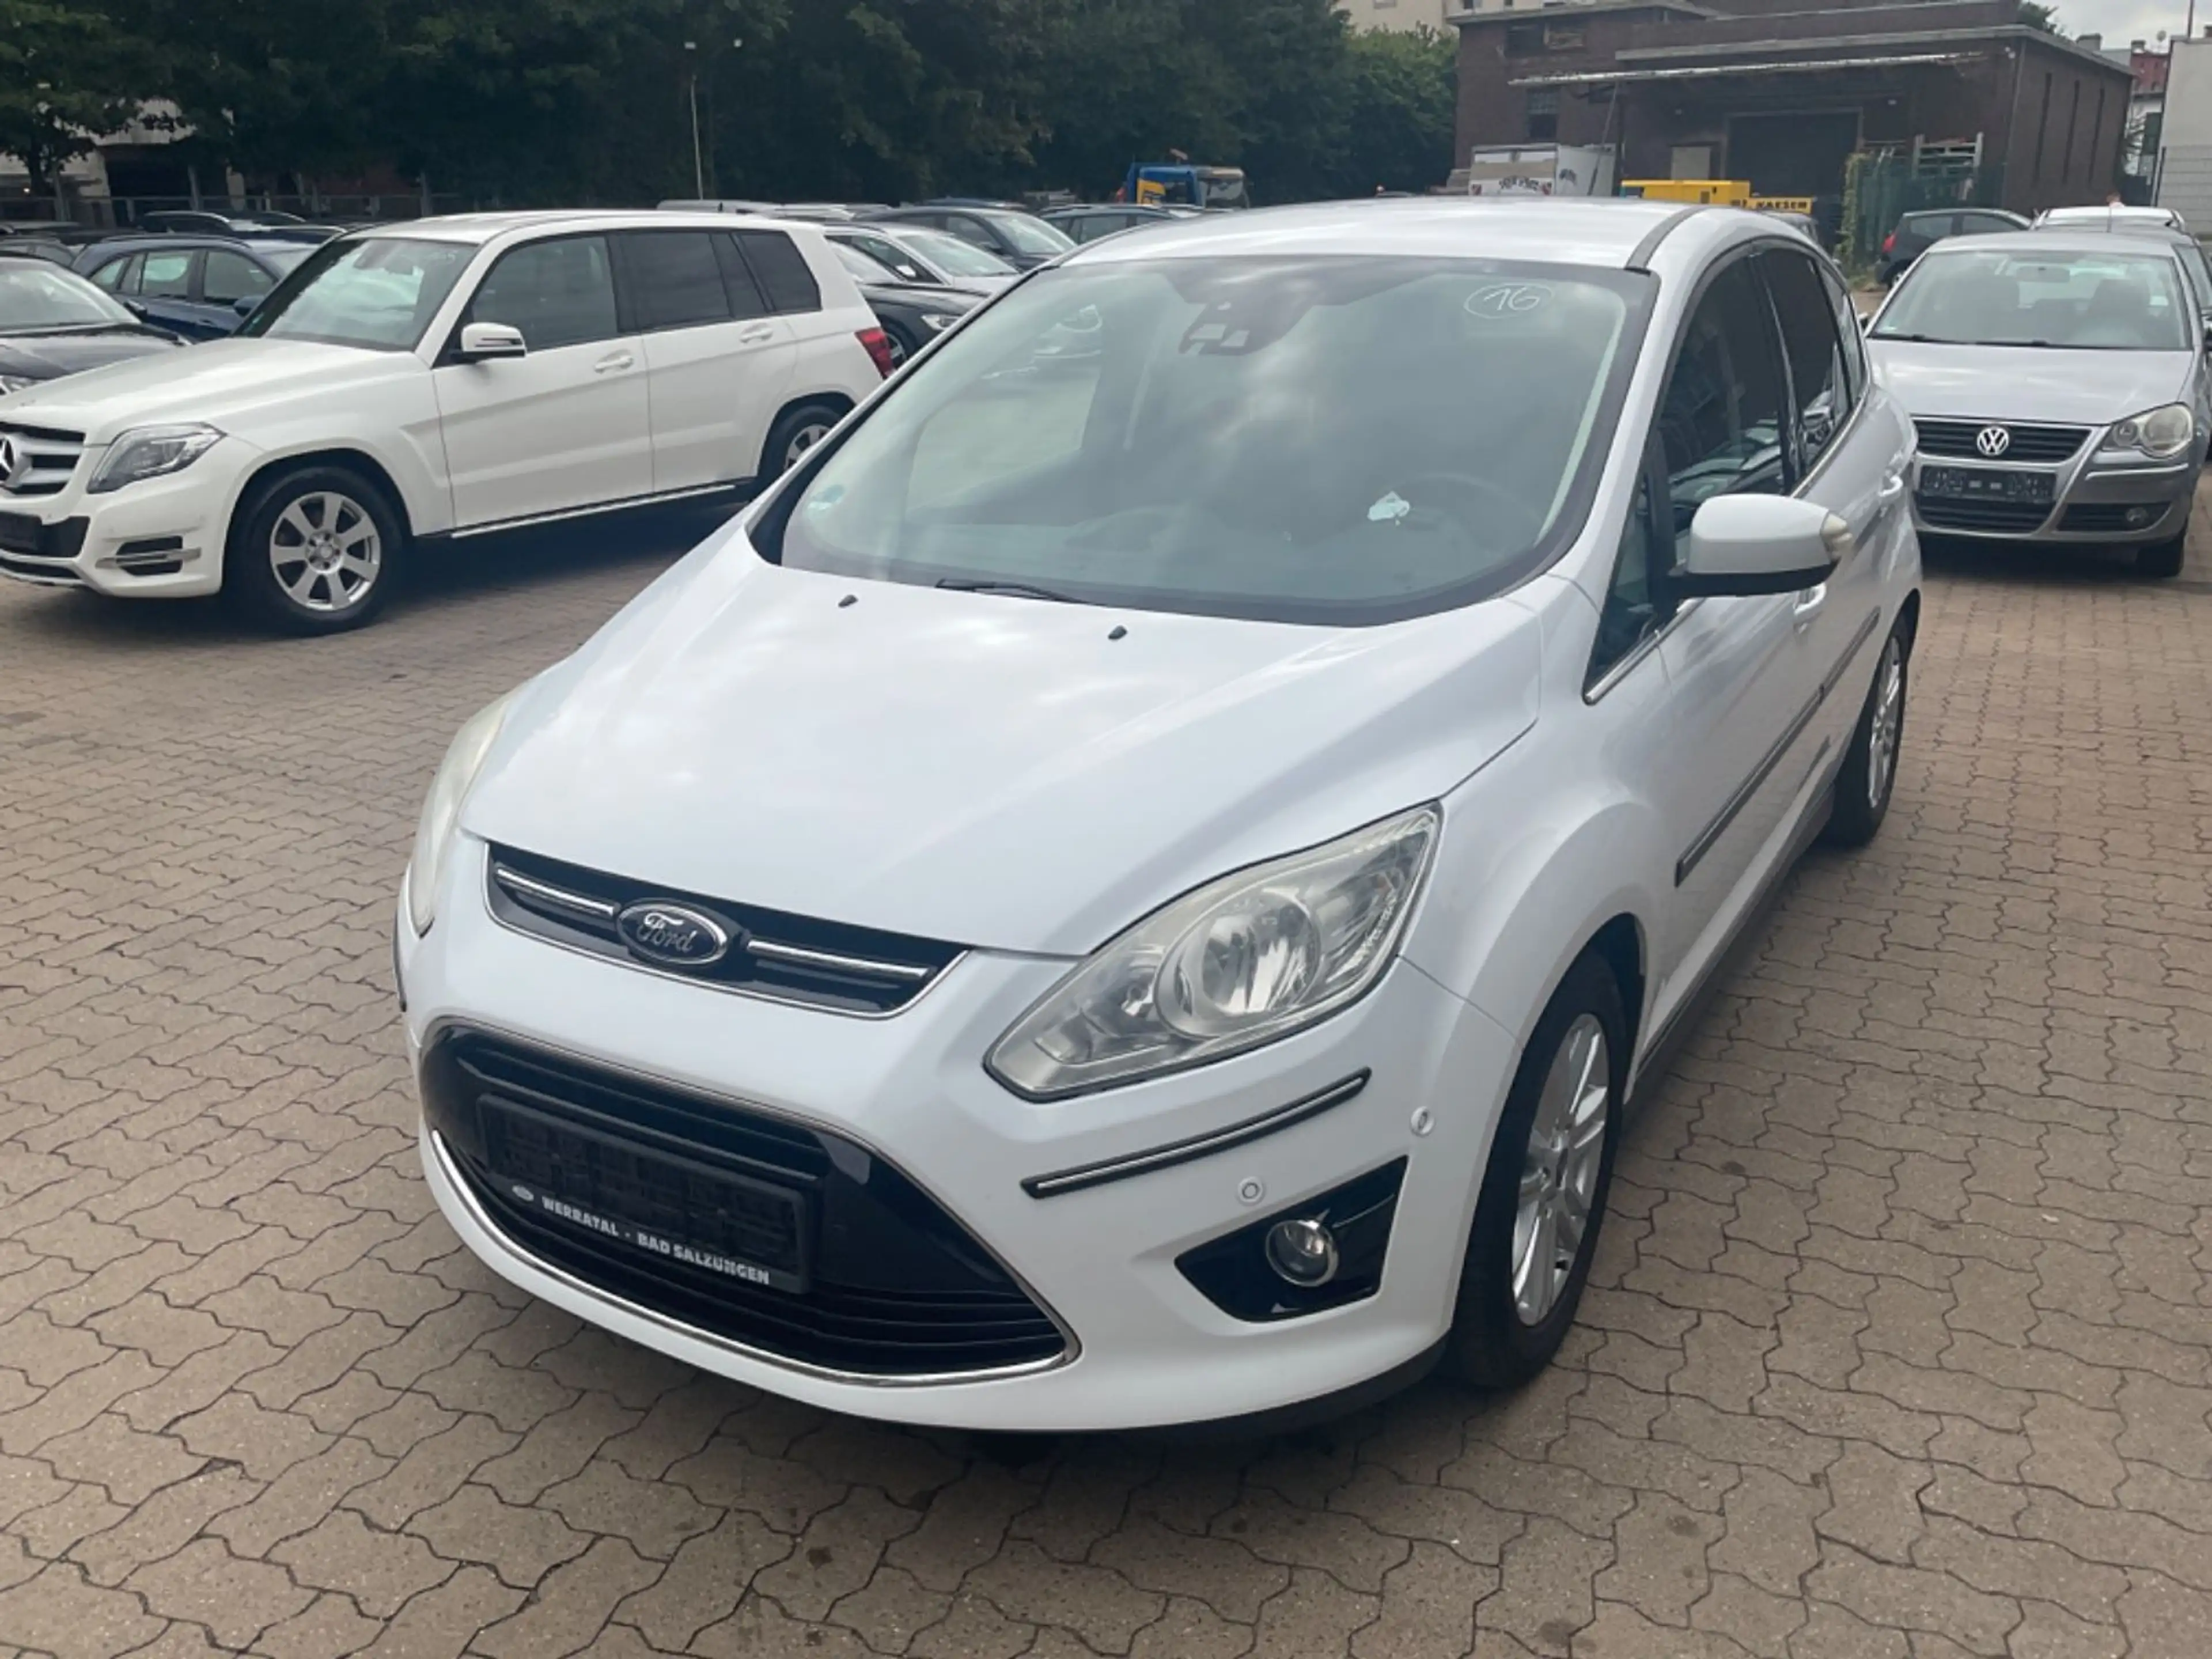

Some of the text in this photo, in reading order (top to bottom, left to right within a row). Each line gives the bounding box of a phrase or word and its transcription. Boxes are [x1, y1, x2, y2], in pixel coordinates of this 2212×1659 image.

[637, 912, 698, 953] Ford
[541, 1196, 619, 1237] WERRATAL
[637, 1231, 671, 1255] BAD
[673, 1244, 770, 1285] SALZUNGEN
